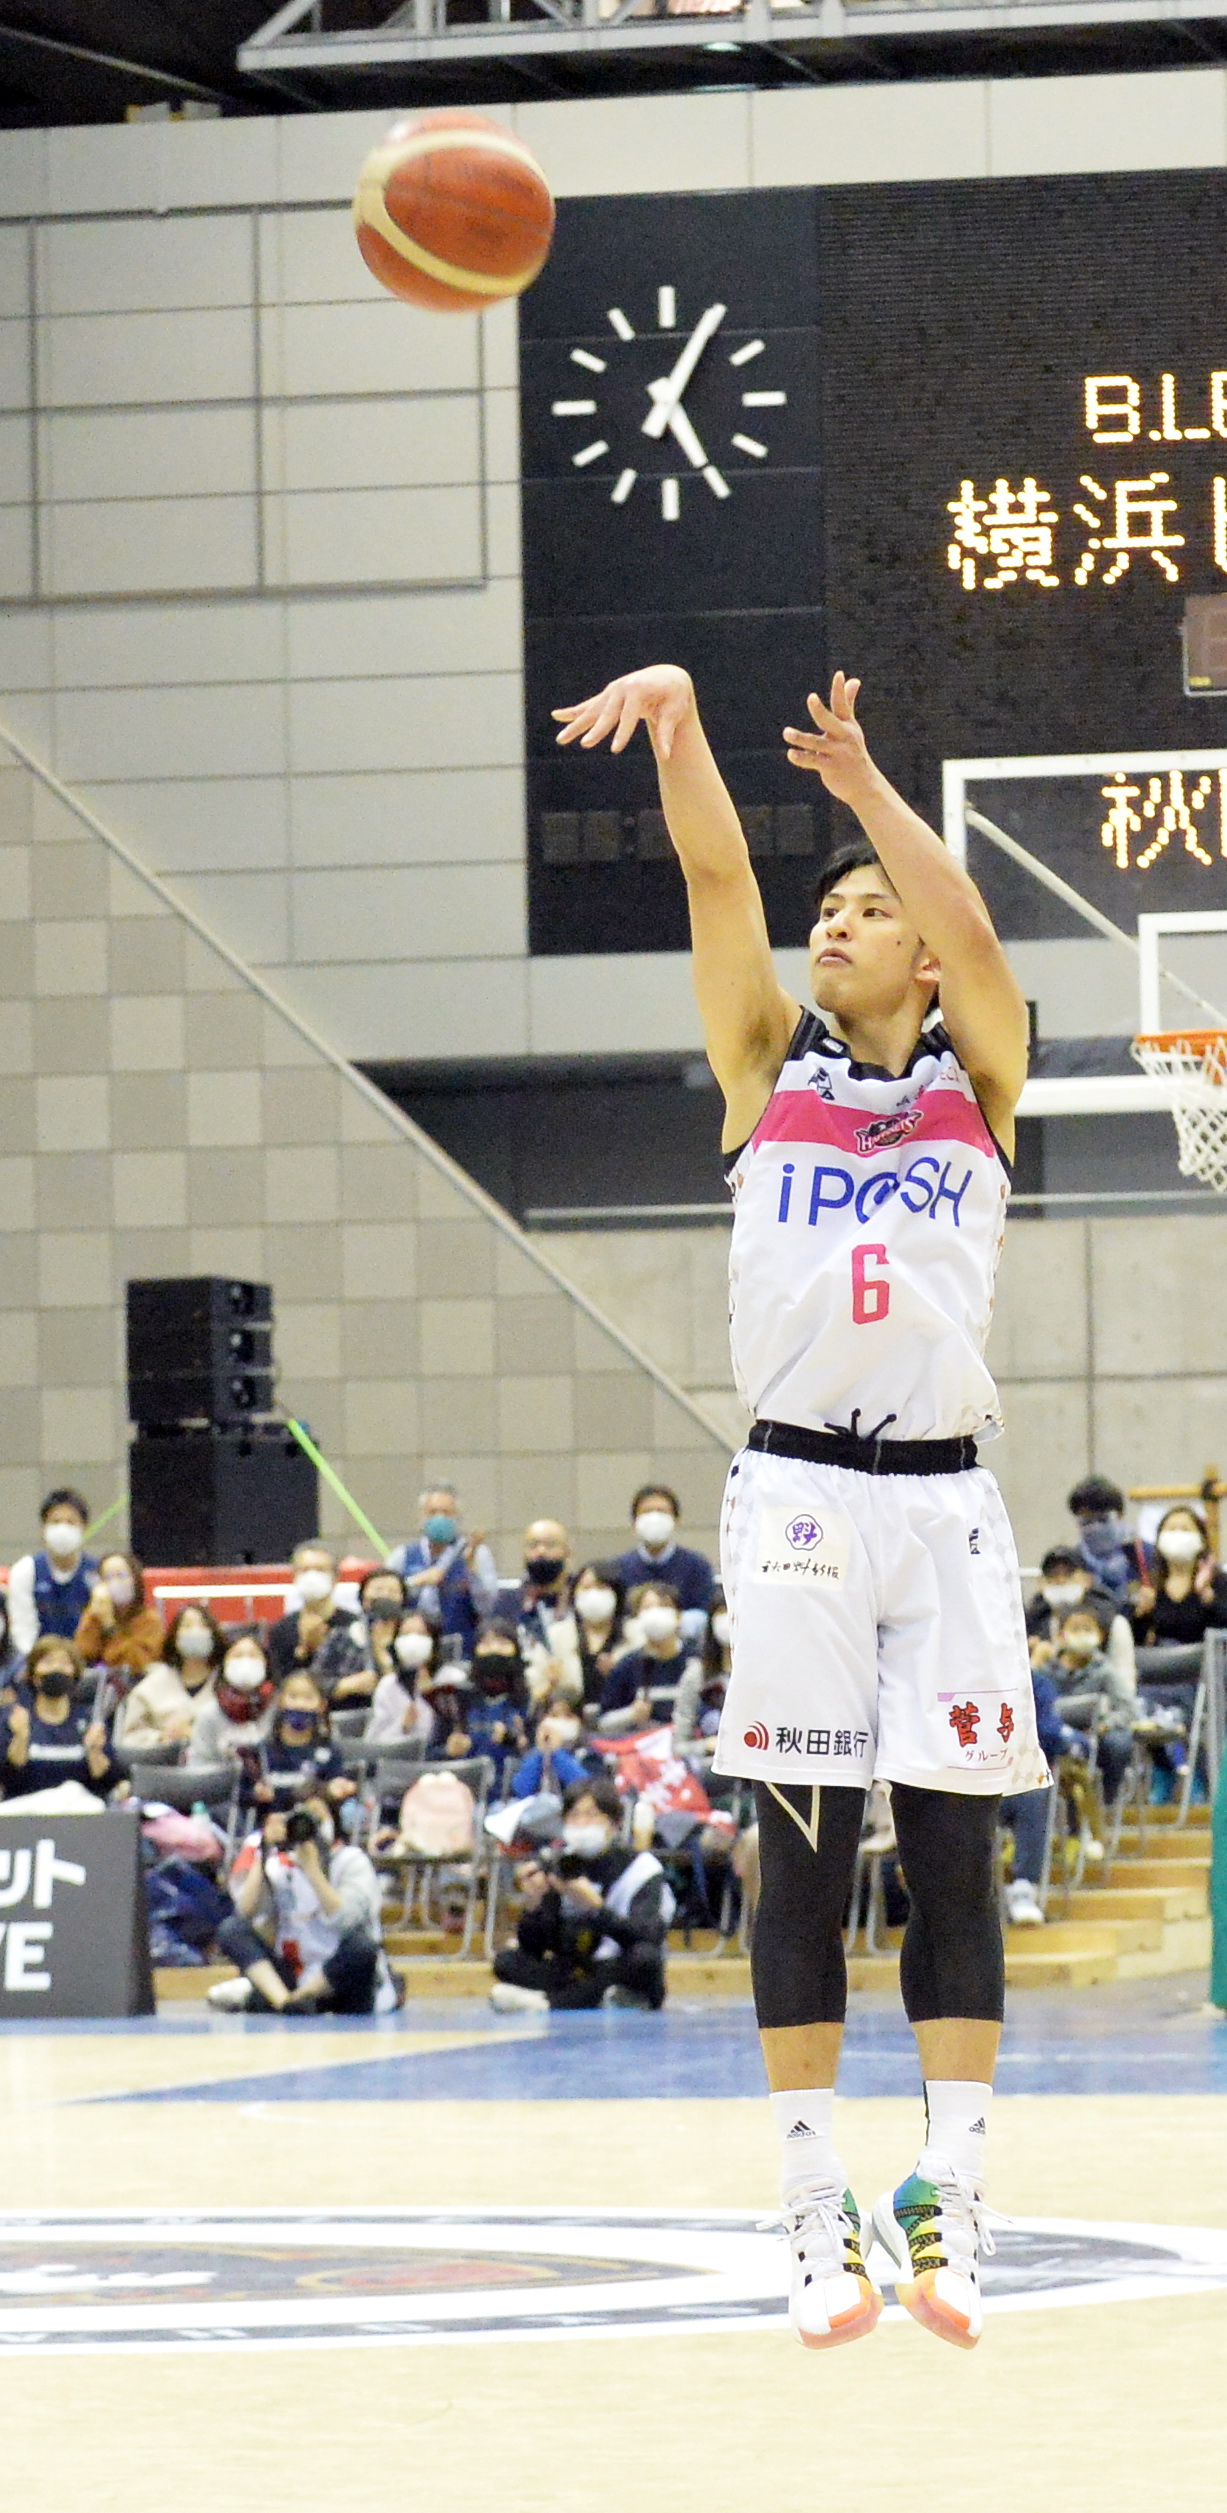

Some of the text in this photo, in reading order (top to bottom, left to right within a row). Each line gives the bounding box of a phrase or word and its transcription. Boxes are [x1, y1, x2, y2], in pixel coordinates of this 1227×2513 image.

[1101, 768, 1227, 869] 秋
[851, 1243, 890, 1325] 6
[775, 1726, 869, 1758] 秋田銀行
